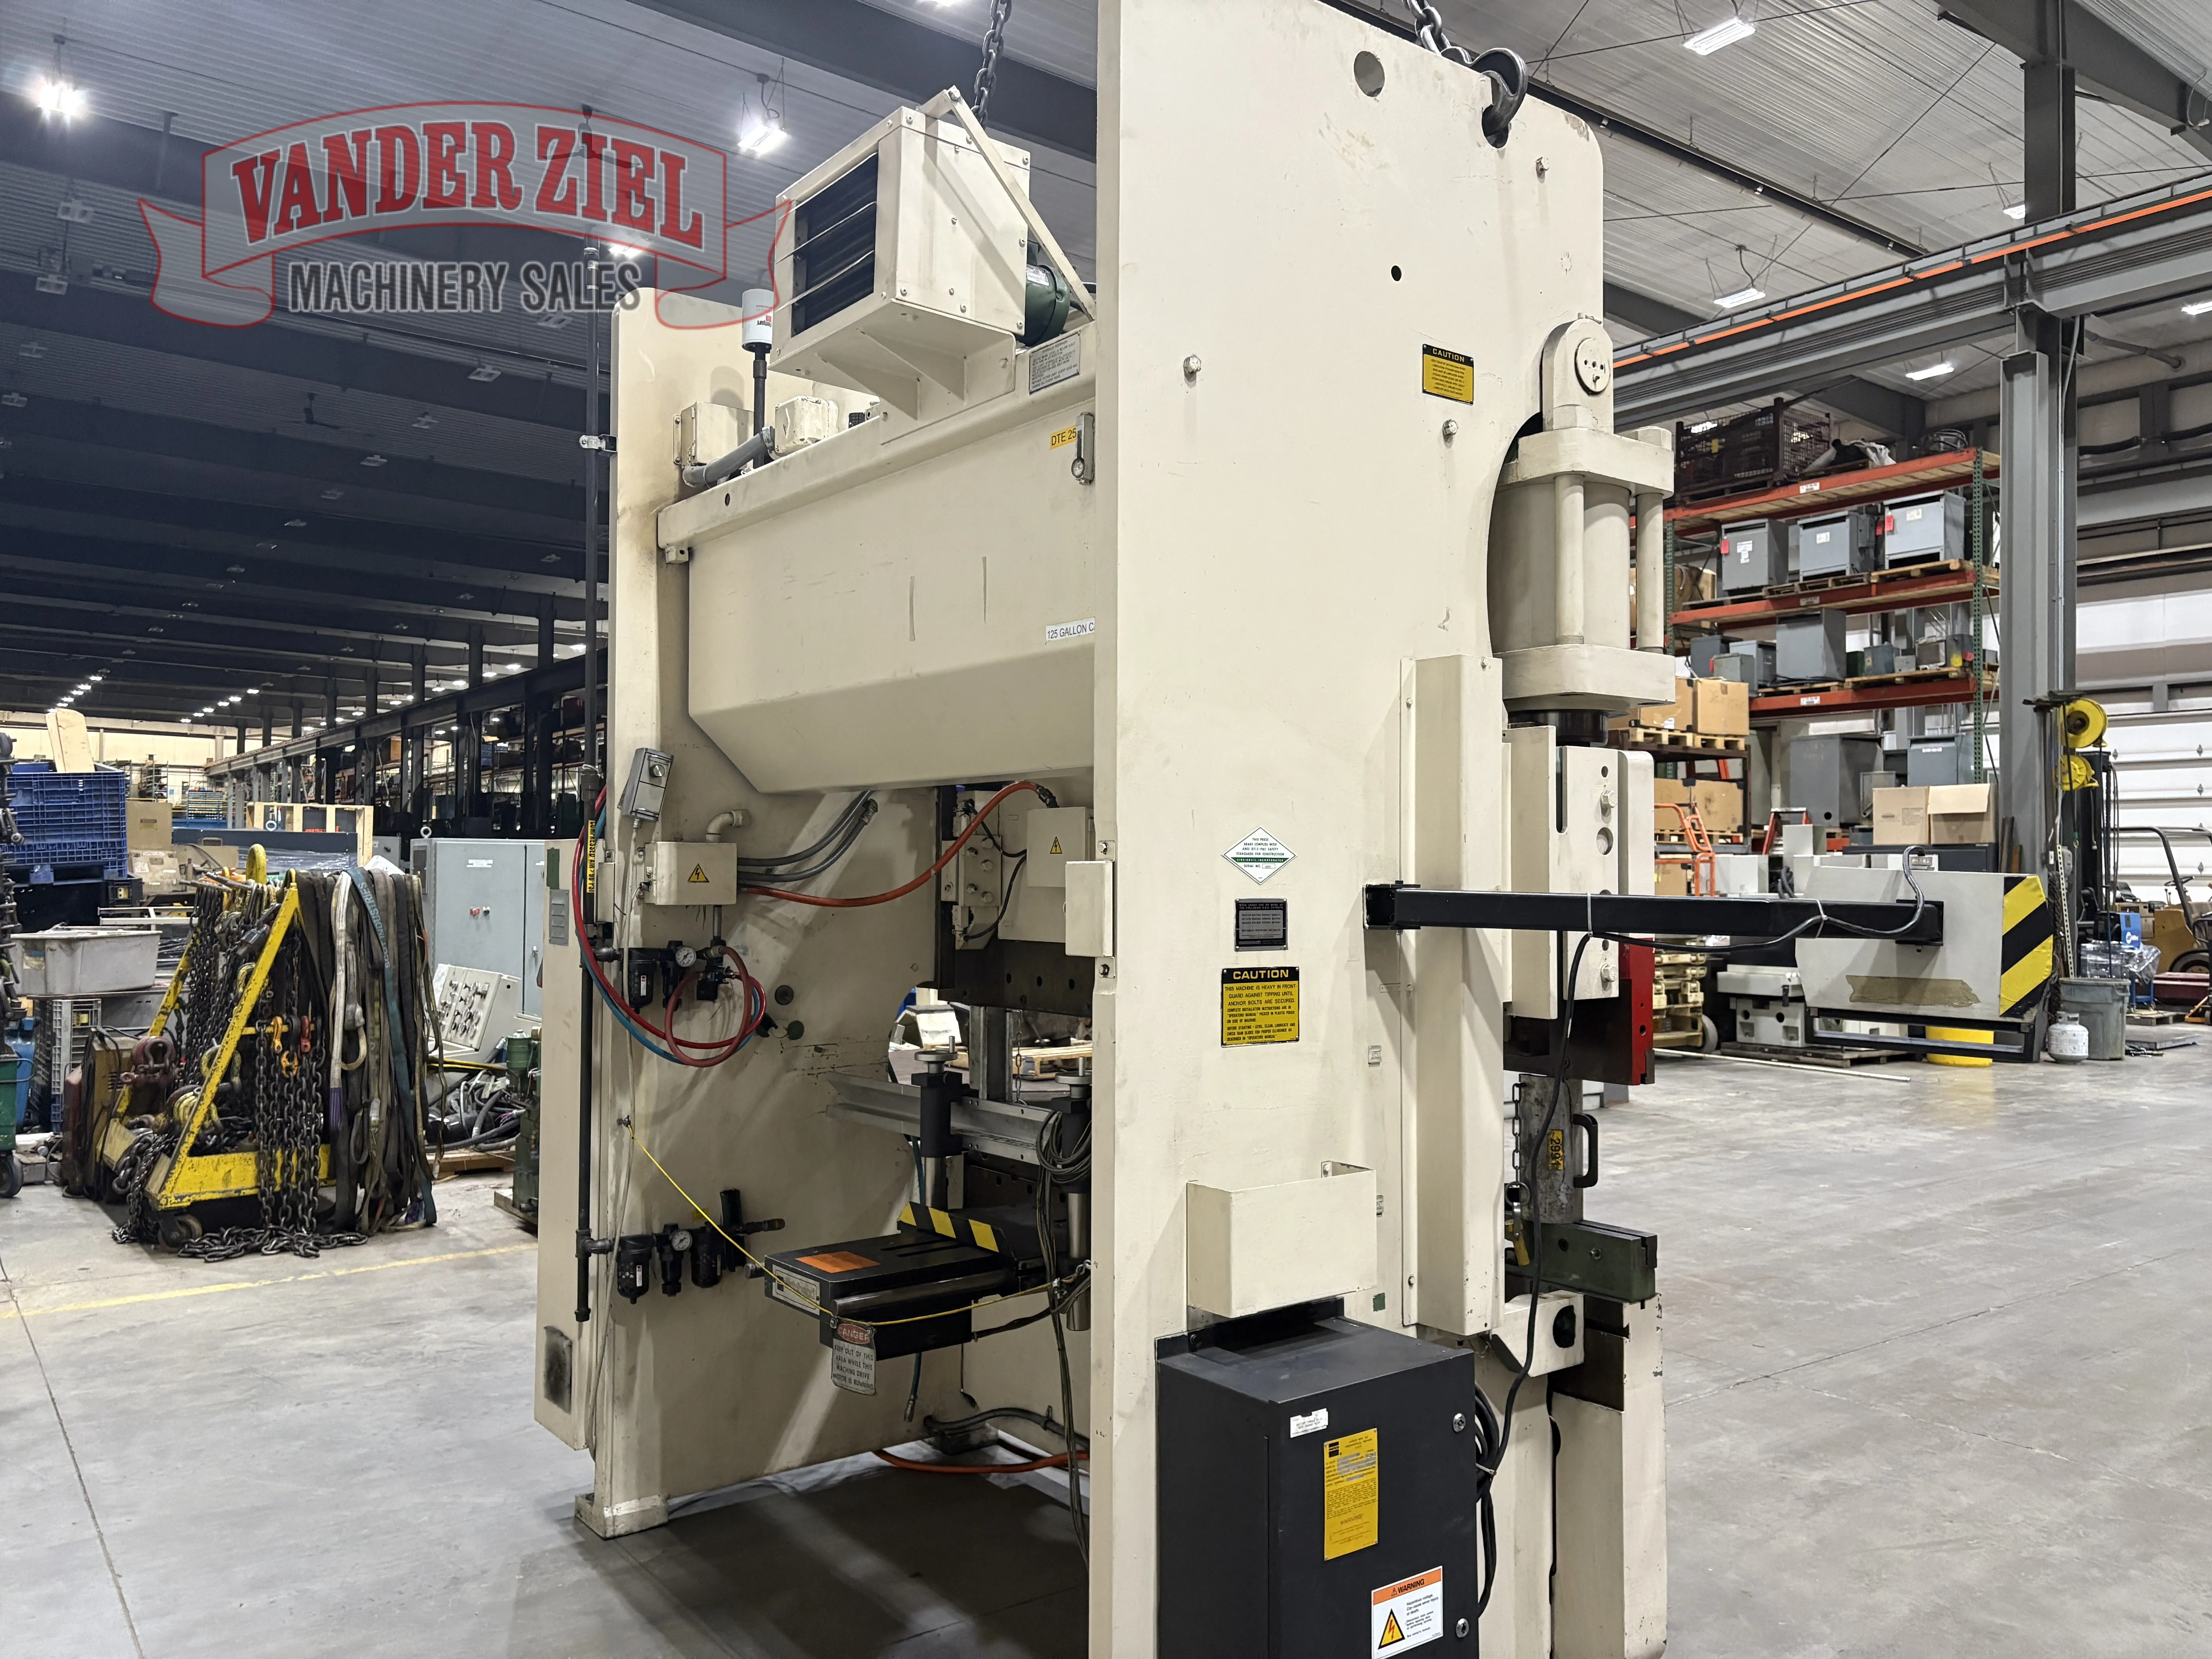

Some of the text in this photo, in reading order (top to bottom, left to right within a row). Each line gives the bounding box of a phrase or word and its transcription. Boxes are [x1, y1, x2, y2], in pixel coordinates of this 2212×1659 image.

[1433, 348, 1464, 362] CAUTION
[1051, 428, 1077, 446] DTE 25
[1048, 630, 1058, 639] 125
[1060, 624, 1087, 637] GALLON
[358, 882, 390, 968] SCOT INDUSTRIES
[1233, 969, 1288, 979] CAUTION
[839, 1328, 870, 1341] DANGER
[848, 1358, 861, 1367] WHILE
[833, 1373, 846, 1382] MOTOR
[836, 1365, 869, 1379] MACHINE DRIVE
[1398, 1579, 1425, 1594] WARNING
